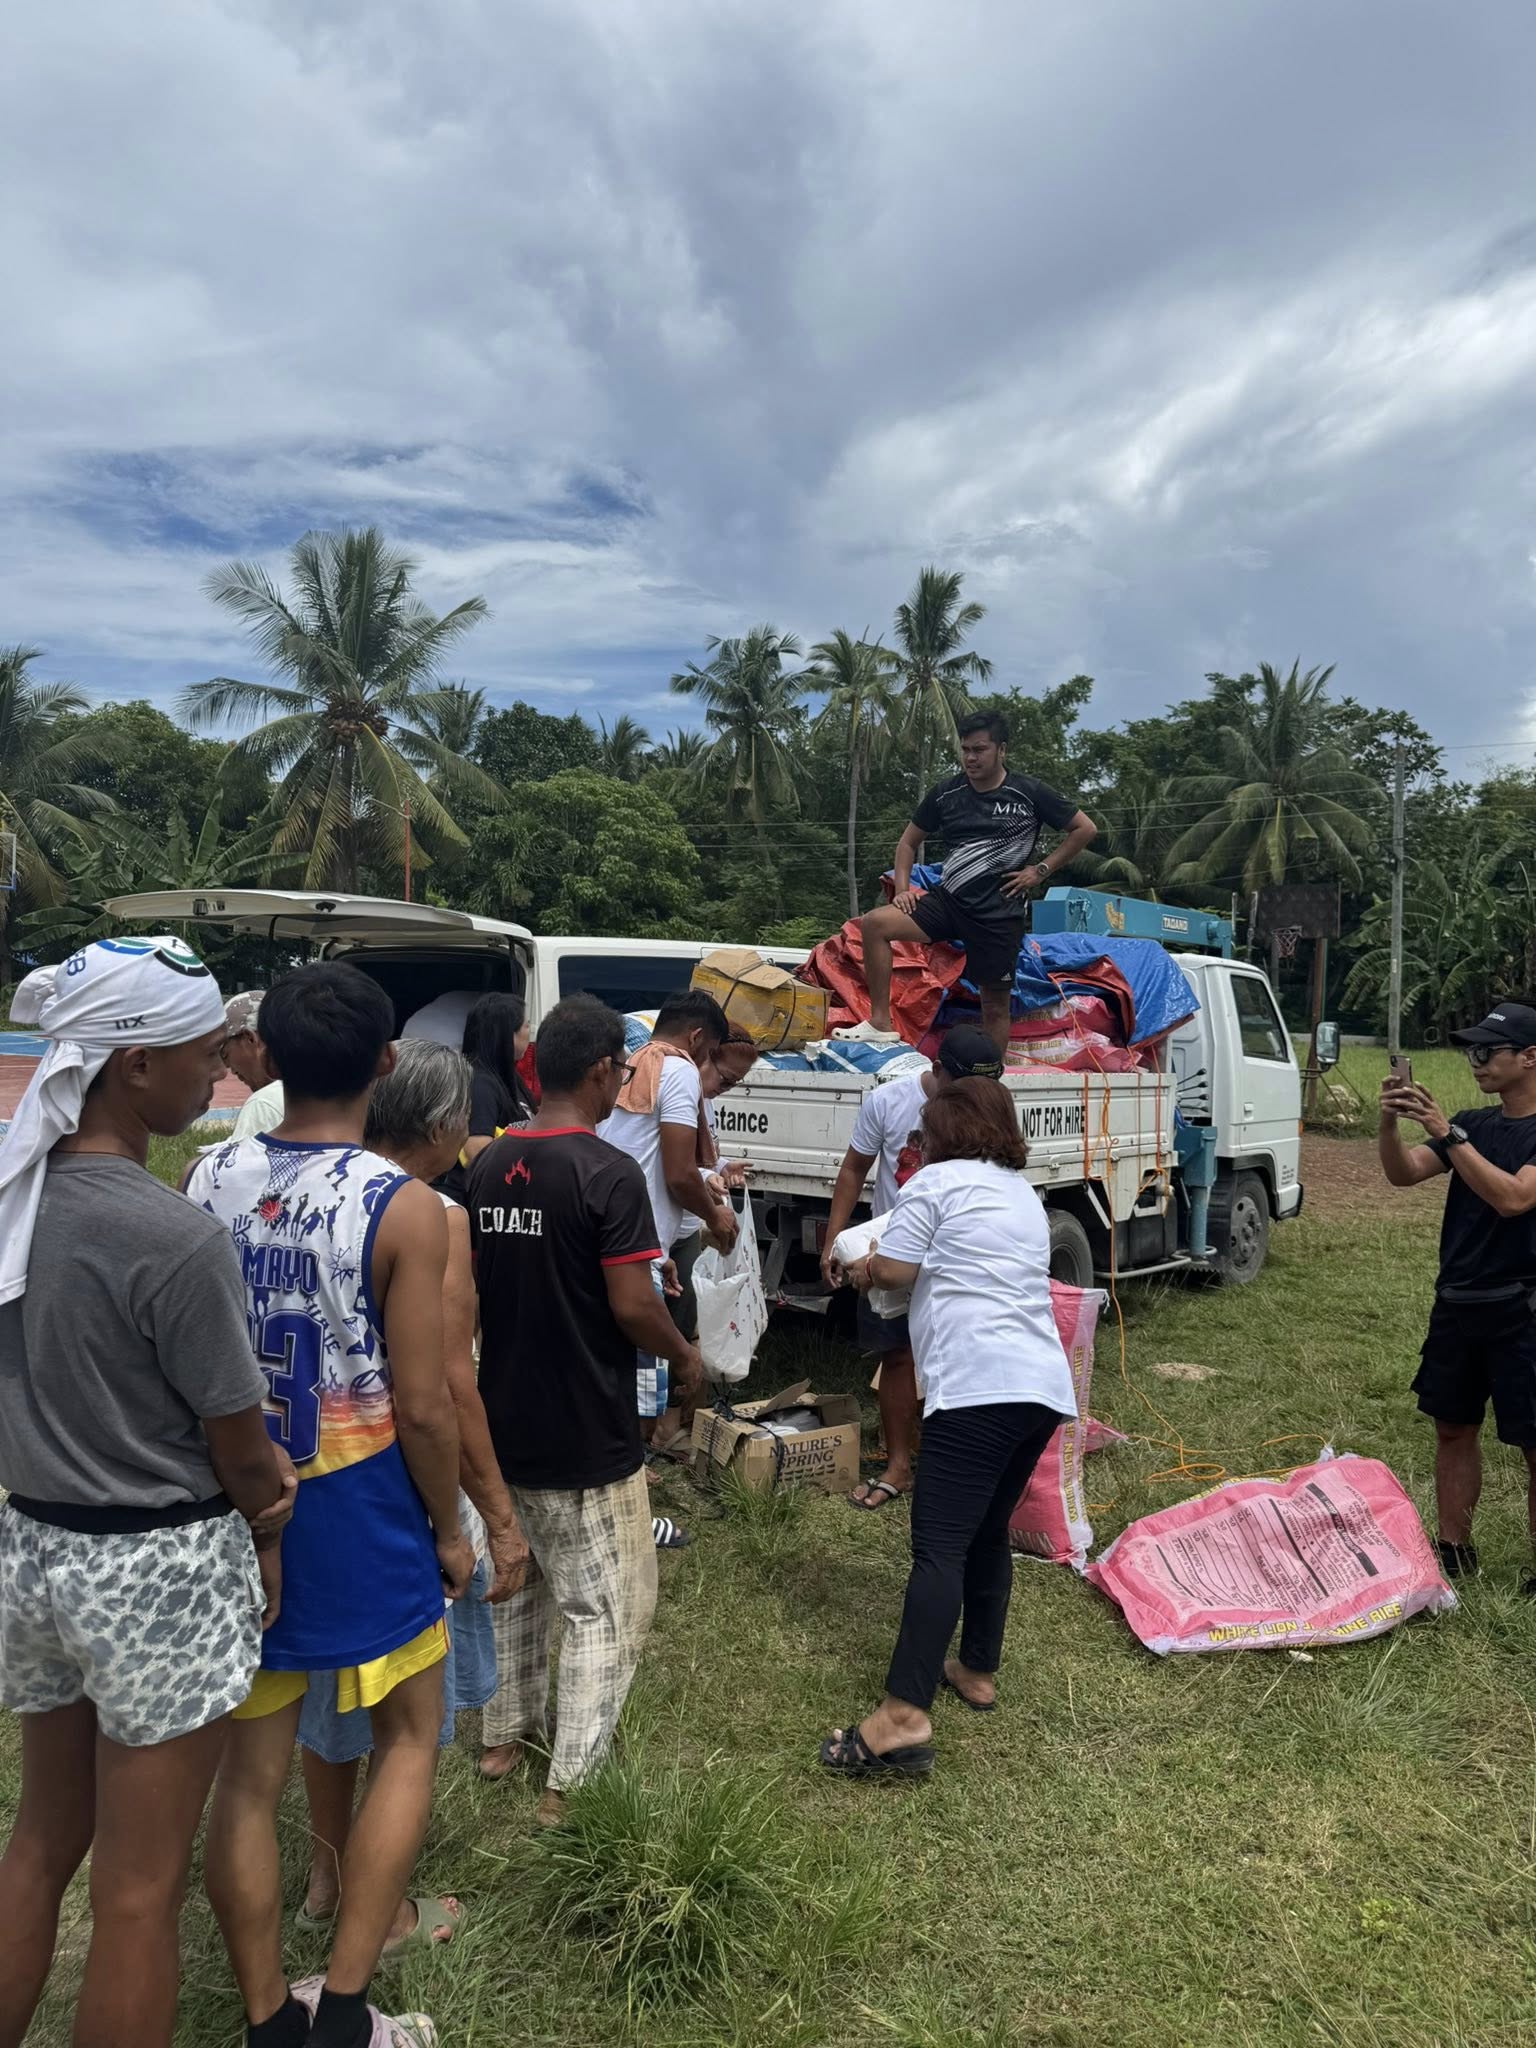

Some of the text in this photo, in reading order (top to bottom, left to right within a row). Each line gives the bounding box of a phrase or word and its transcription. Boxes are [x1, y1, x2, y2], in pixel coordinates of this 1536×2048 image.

[1022, 1105, 1085, 1138] NOT FOR HIRE
[479, 1206, 543, 1236] COACH
[240, 1242, 320, 1295] MAYO
[248, 1309, 324, 1464] 3
[782, 1450, 834, 1469] SPRING
[1063, 1442, 1074, 1475] LION
[1208, 1625, 1260, 1642] WHITE
[1263, 1621, 1297, 1635] LION
[1369, 1602, 1403, 1621] RICE
